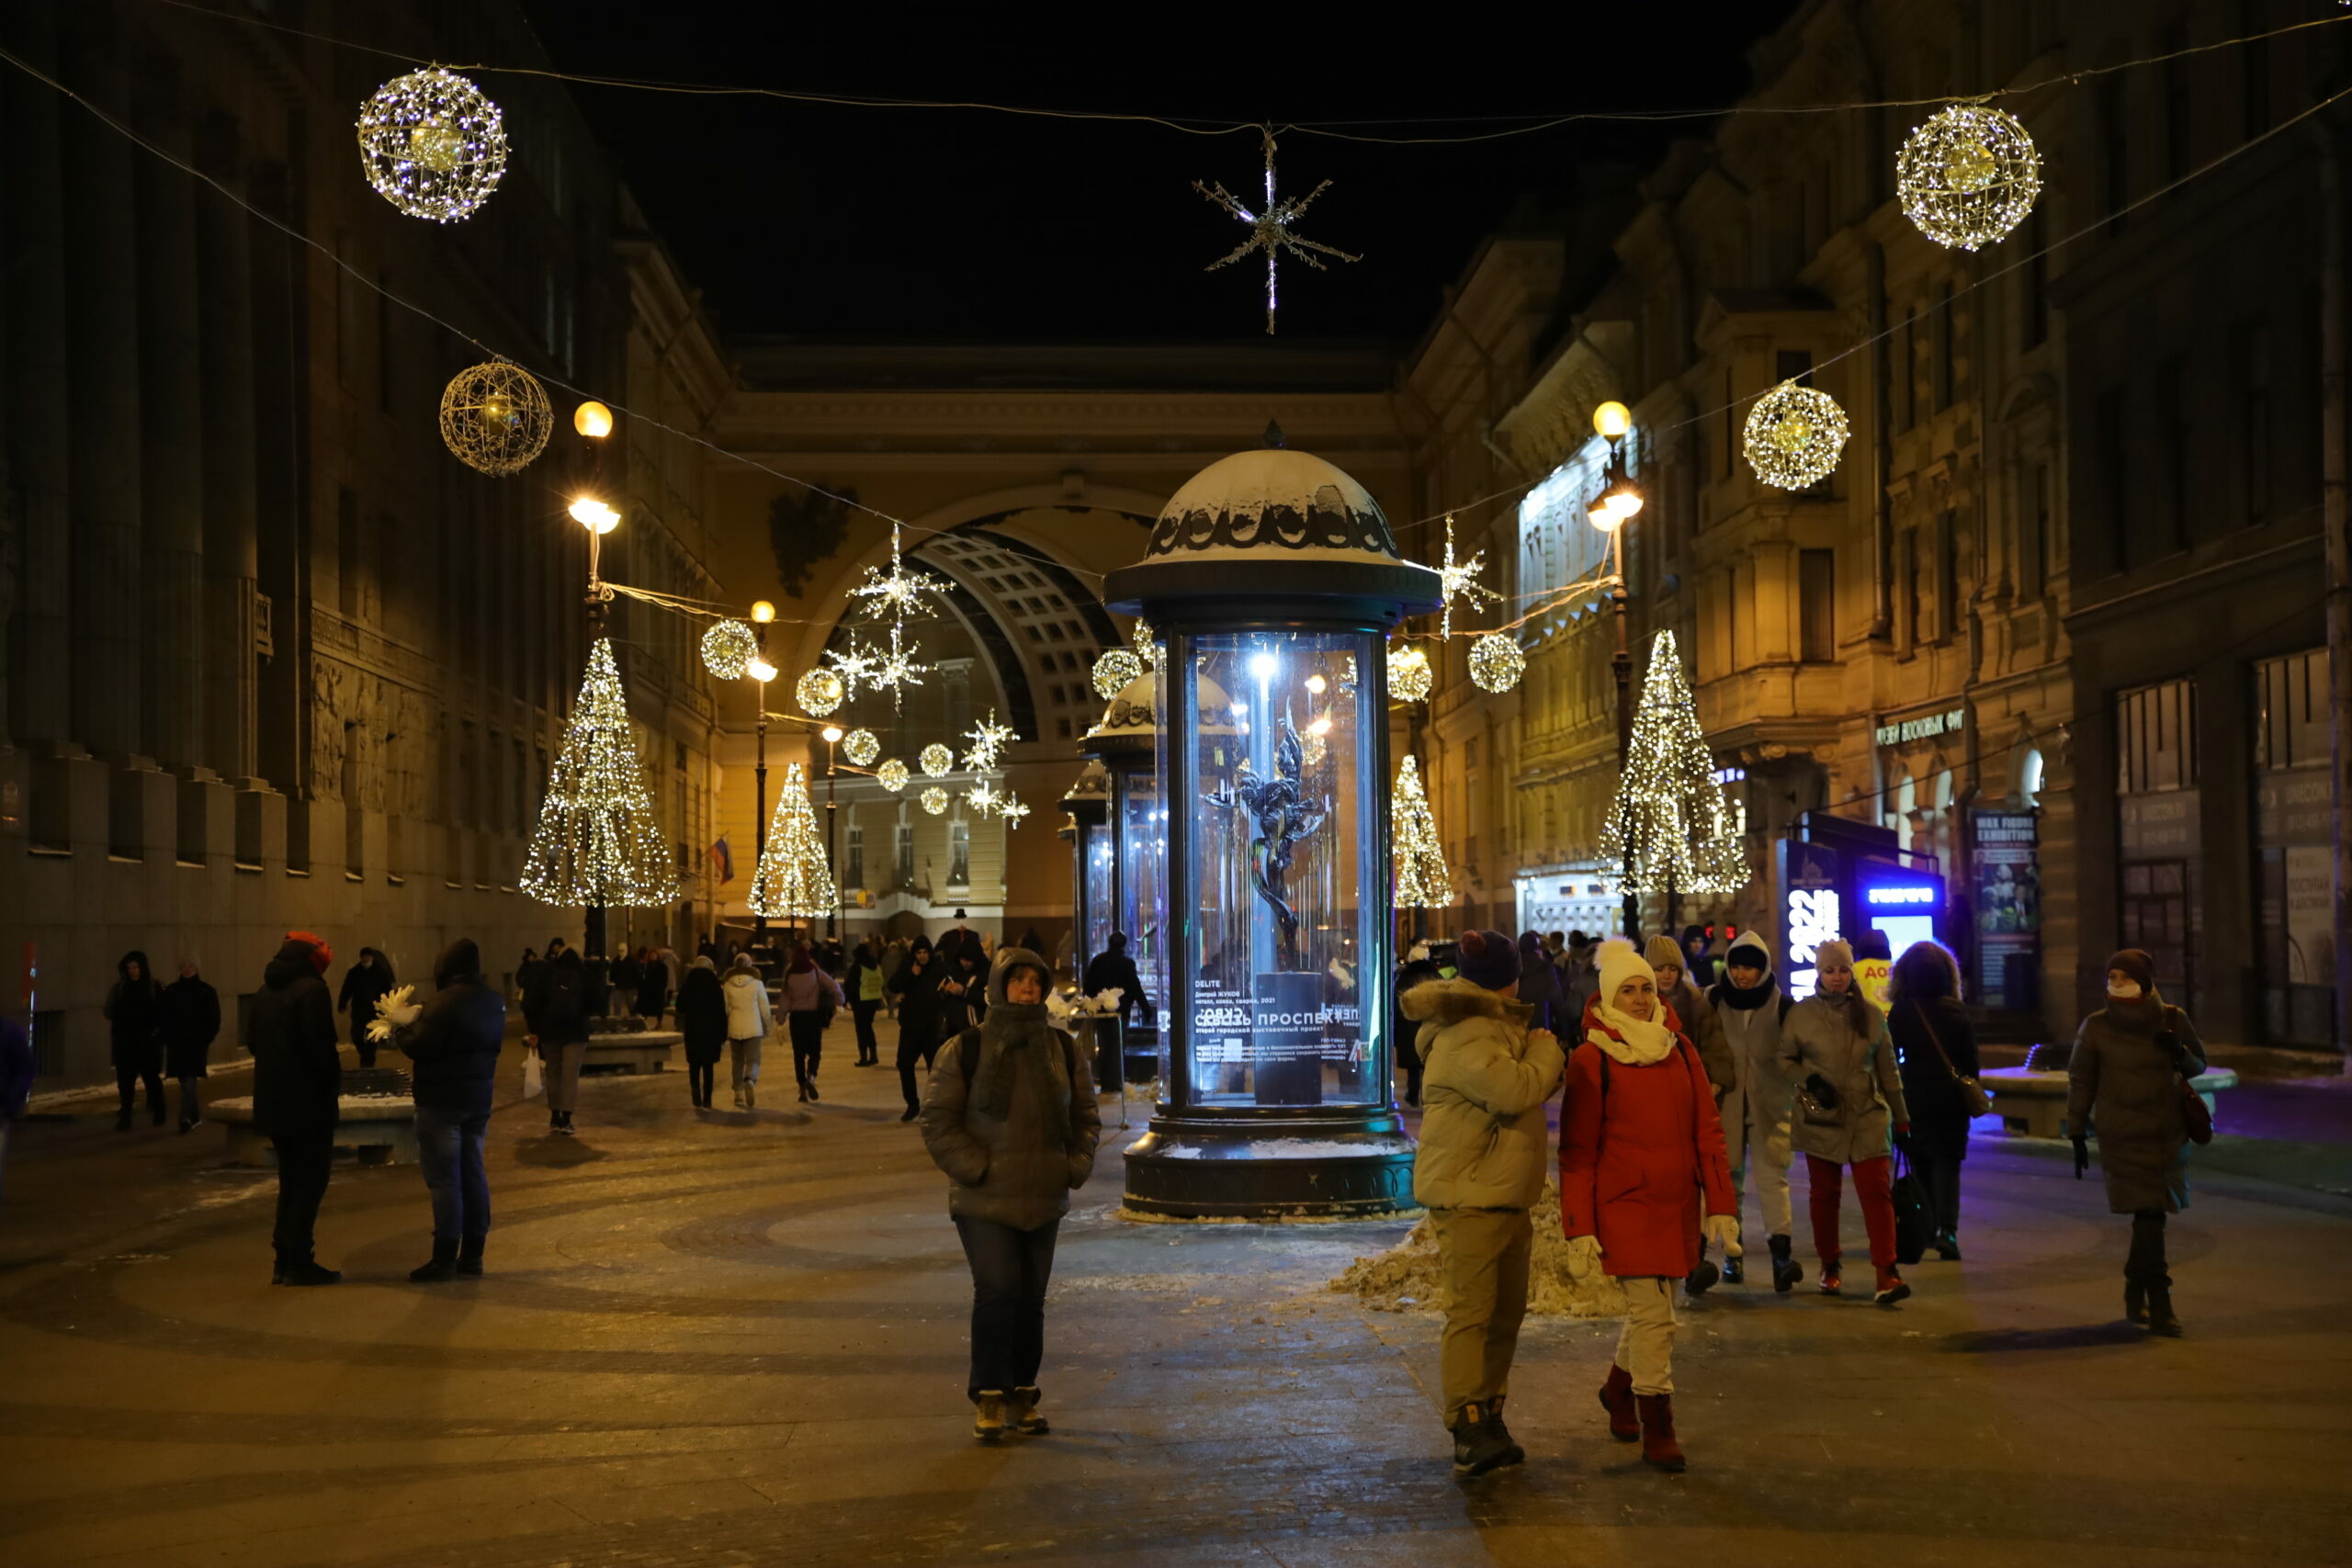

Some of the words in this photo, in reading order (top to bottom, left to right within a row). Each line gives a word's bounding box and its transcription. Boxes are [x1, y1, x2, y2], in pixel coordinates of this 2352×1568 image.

[1976, 817, 1999, 829] WAX
[1977, 829, 2035, 841] EXHIBITION
[1195, 980, 1220, 988] DELITE
[1258, 1013, 1340, 1025] ПРОСПЕКТ
